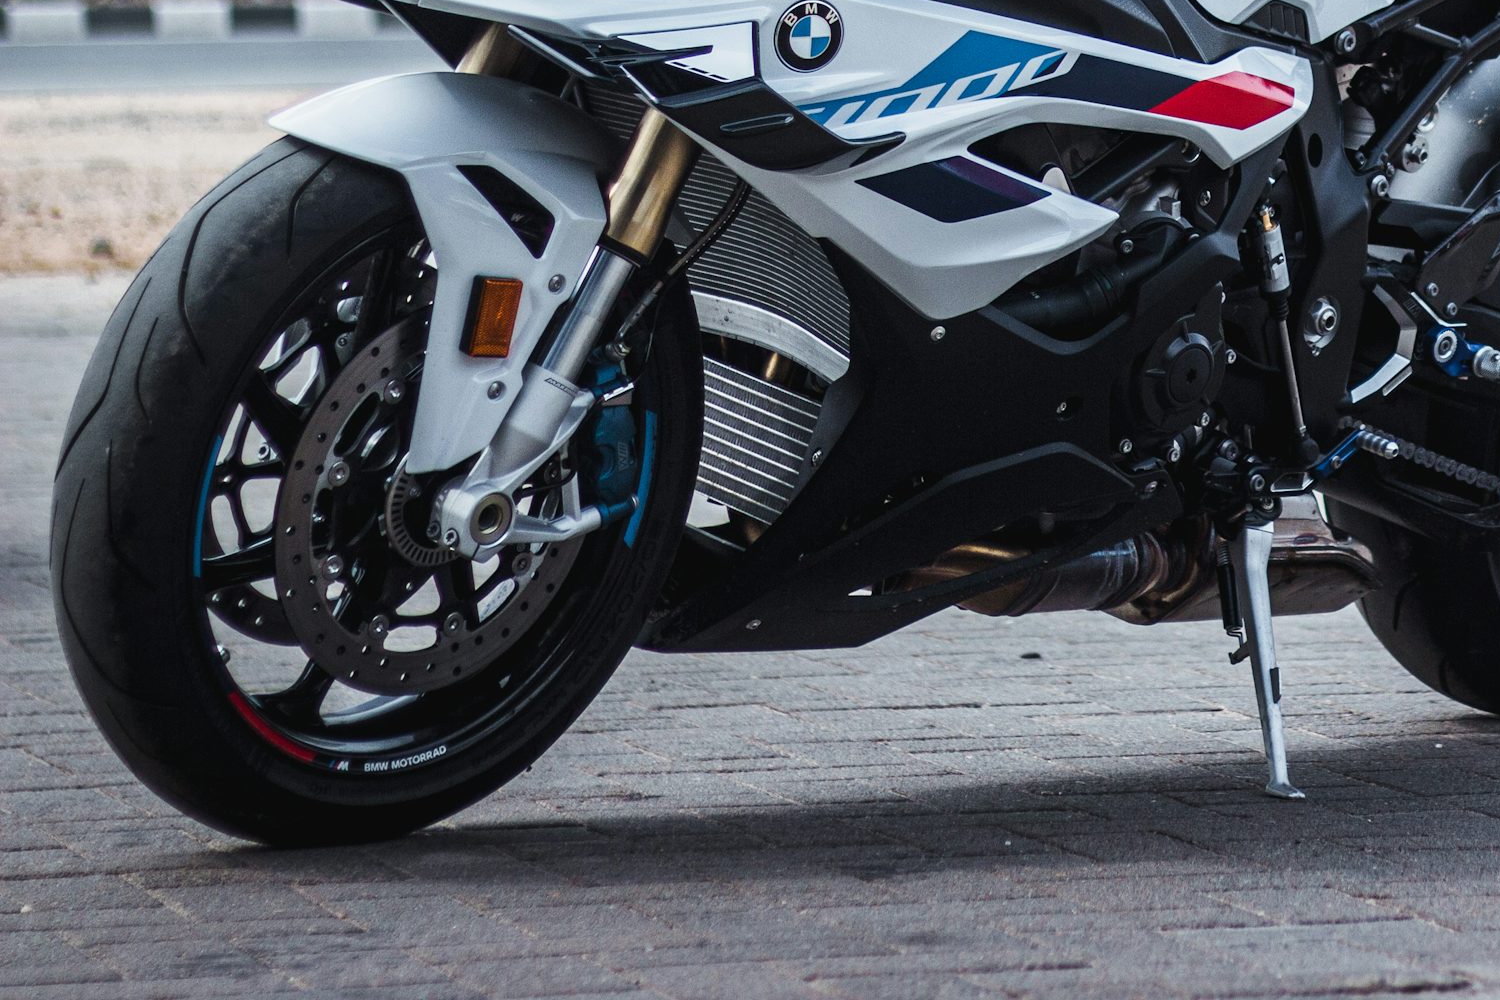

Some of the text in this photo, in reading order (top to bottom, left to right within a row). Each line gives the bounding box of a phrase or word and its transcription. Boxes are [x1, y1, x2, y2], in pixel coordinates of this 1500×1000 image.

[784, 3, 839, 27] BMW
[364, 760, 389, 772] BMW
[391, 745, 447, 770] MOTORRAD
